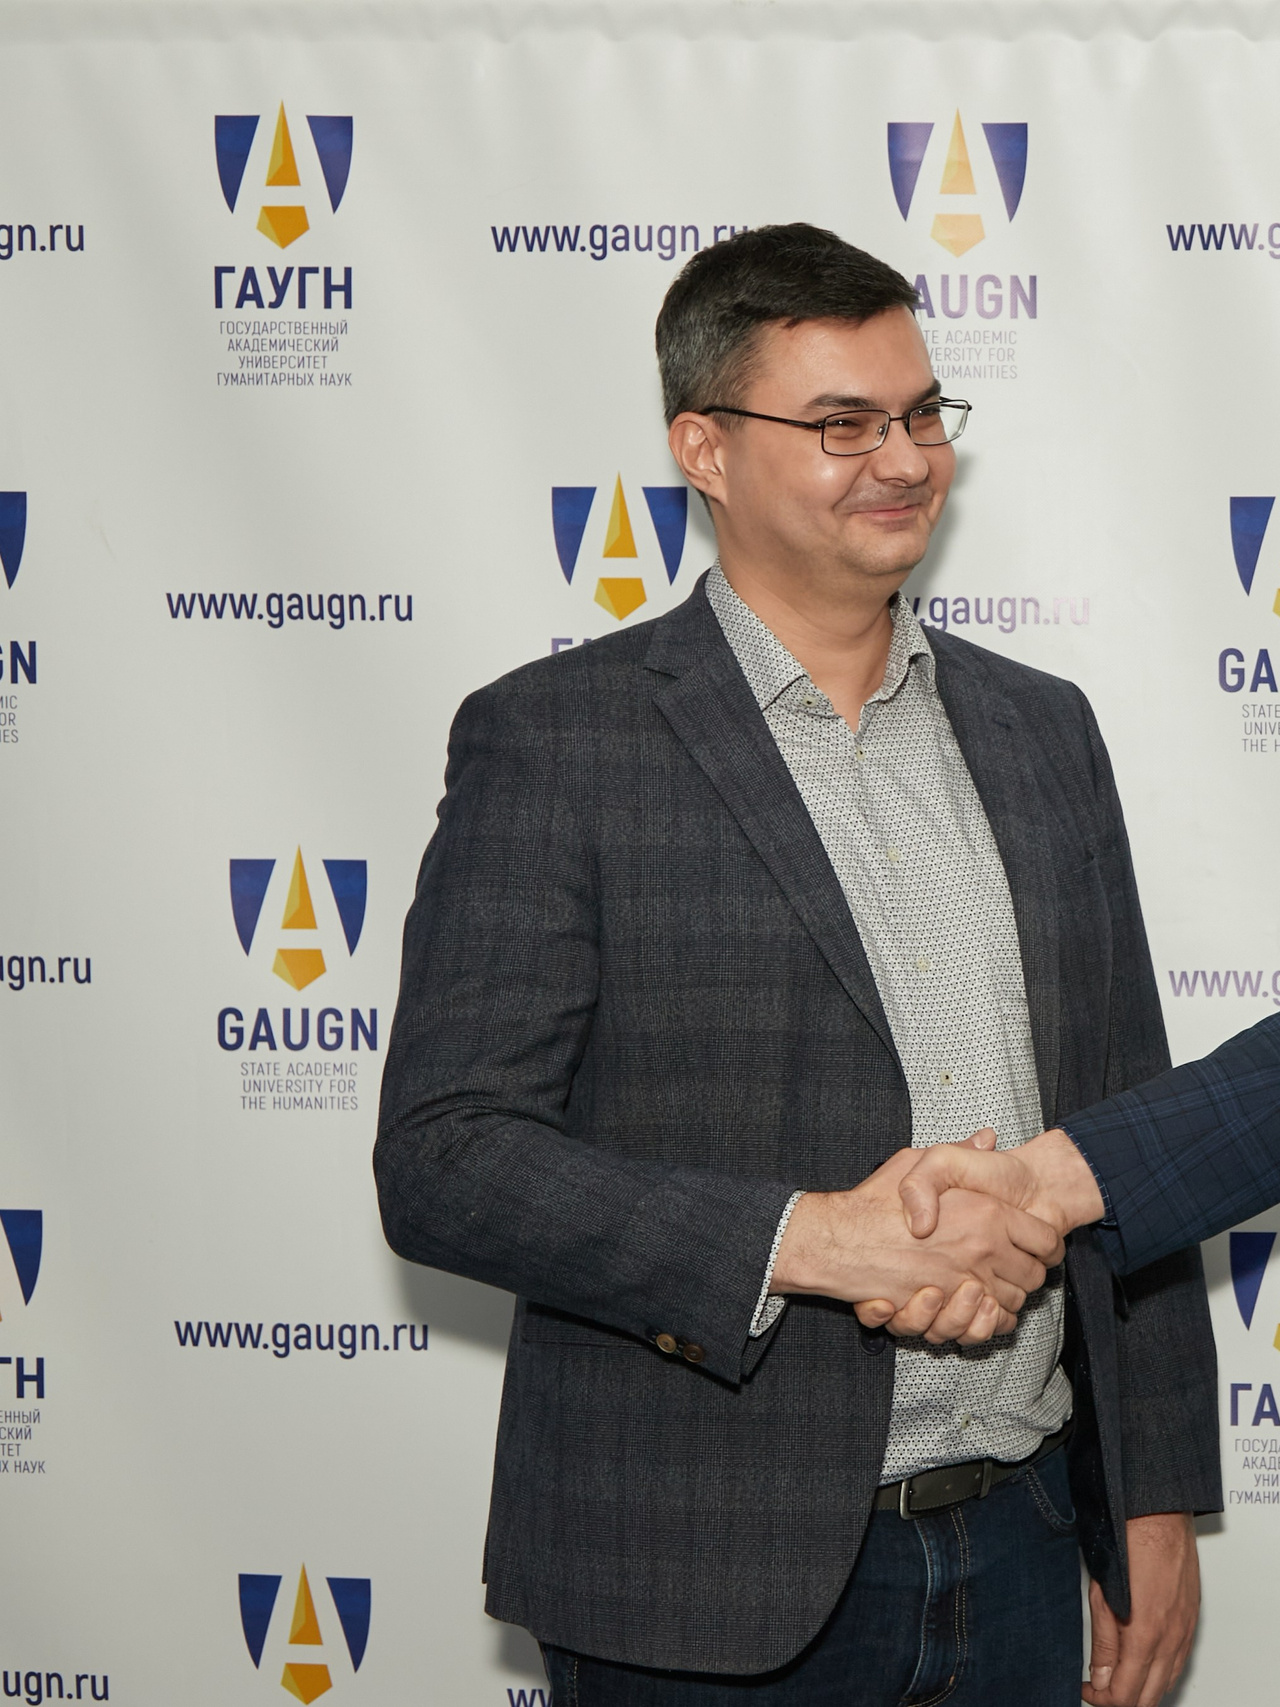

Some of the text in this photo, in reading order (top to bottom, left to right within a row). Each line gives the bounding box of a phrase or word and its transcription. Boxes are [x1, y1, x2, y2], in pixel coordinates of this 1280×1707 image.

[213, 265, 353, 310] ГАУГН
[912, 274, 1037, 319] AUGN
[219, 319, 348, 336] ГОСУДАРСТВЕННЫЙ
[944, 329, 1017, 345] ACADEMIC
[227, 337, 339, 354] АКАДЕМИЧЕСКИЙ
[238, 355, 328, 370] УНИВЕРСИТЕТ
[988, 347, 1015, 362] FOR
[216, 372, 353, 387] ГУМАНИТАРНЫХ НАУК
[166, 592, 414, 630] www.gaugn.ru
[1241, 738, 1268, 753] THE
[217, 1006, 378, 1052] GAUGN
[240, 1061, 358, 1077] STATE ACADEMIC
[242, 1078, 356, 1094] UNIVERSITY FOR
[240, 1095, 359, 1111] THE HUMANITIES
[174, 1320, 430, 1360] www.gaugn.ru
[14, 1460, 46, 1474] НАУК
